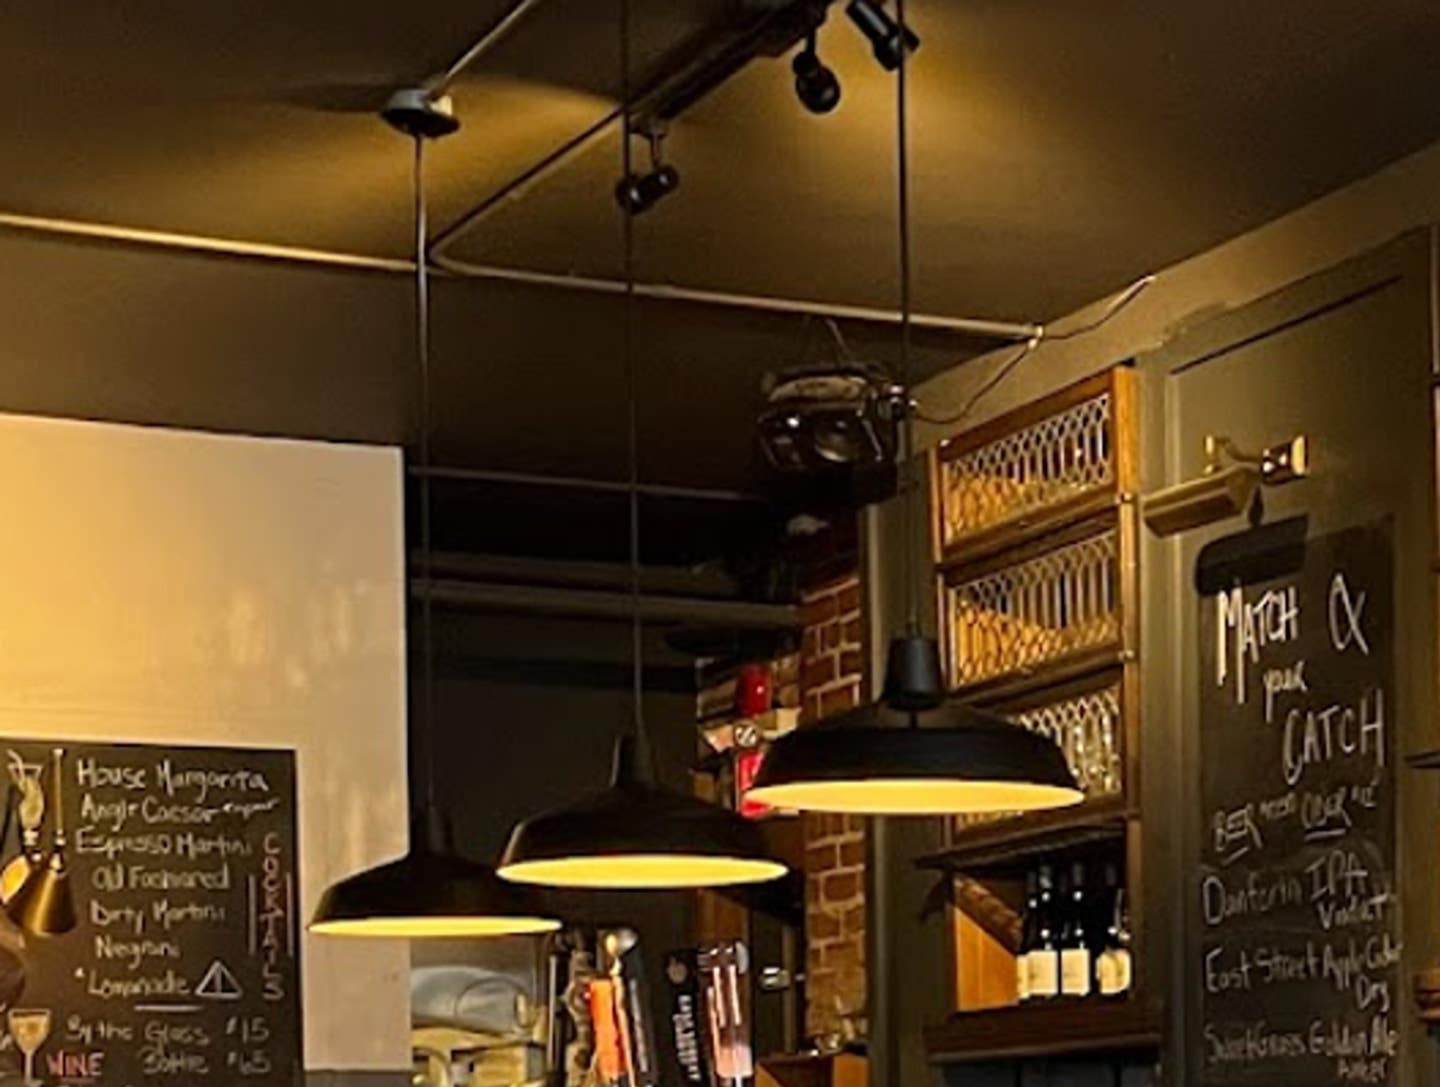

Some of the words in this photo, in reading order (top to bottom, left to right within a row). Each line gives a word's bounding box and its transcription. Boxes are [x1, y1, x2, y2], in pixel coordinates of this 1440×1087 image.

[1216, 585, 1299, 704] MATCH
[1282, 688, 1385, 786] CATCH
[77, 758, 146, 788] House
[155, 758, 270, 804] Margarita
[45, 1048, 105, 1079] WINE
